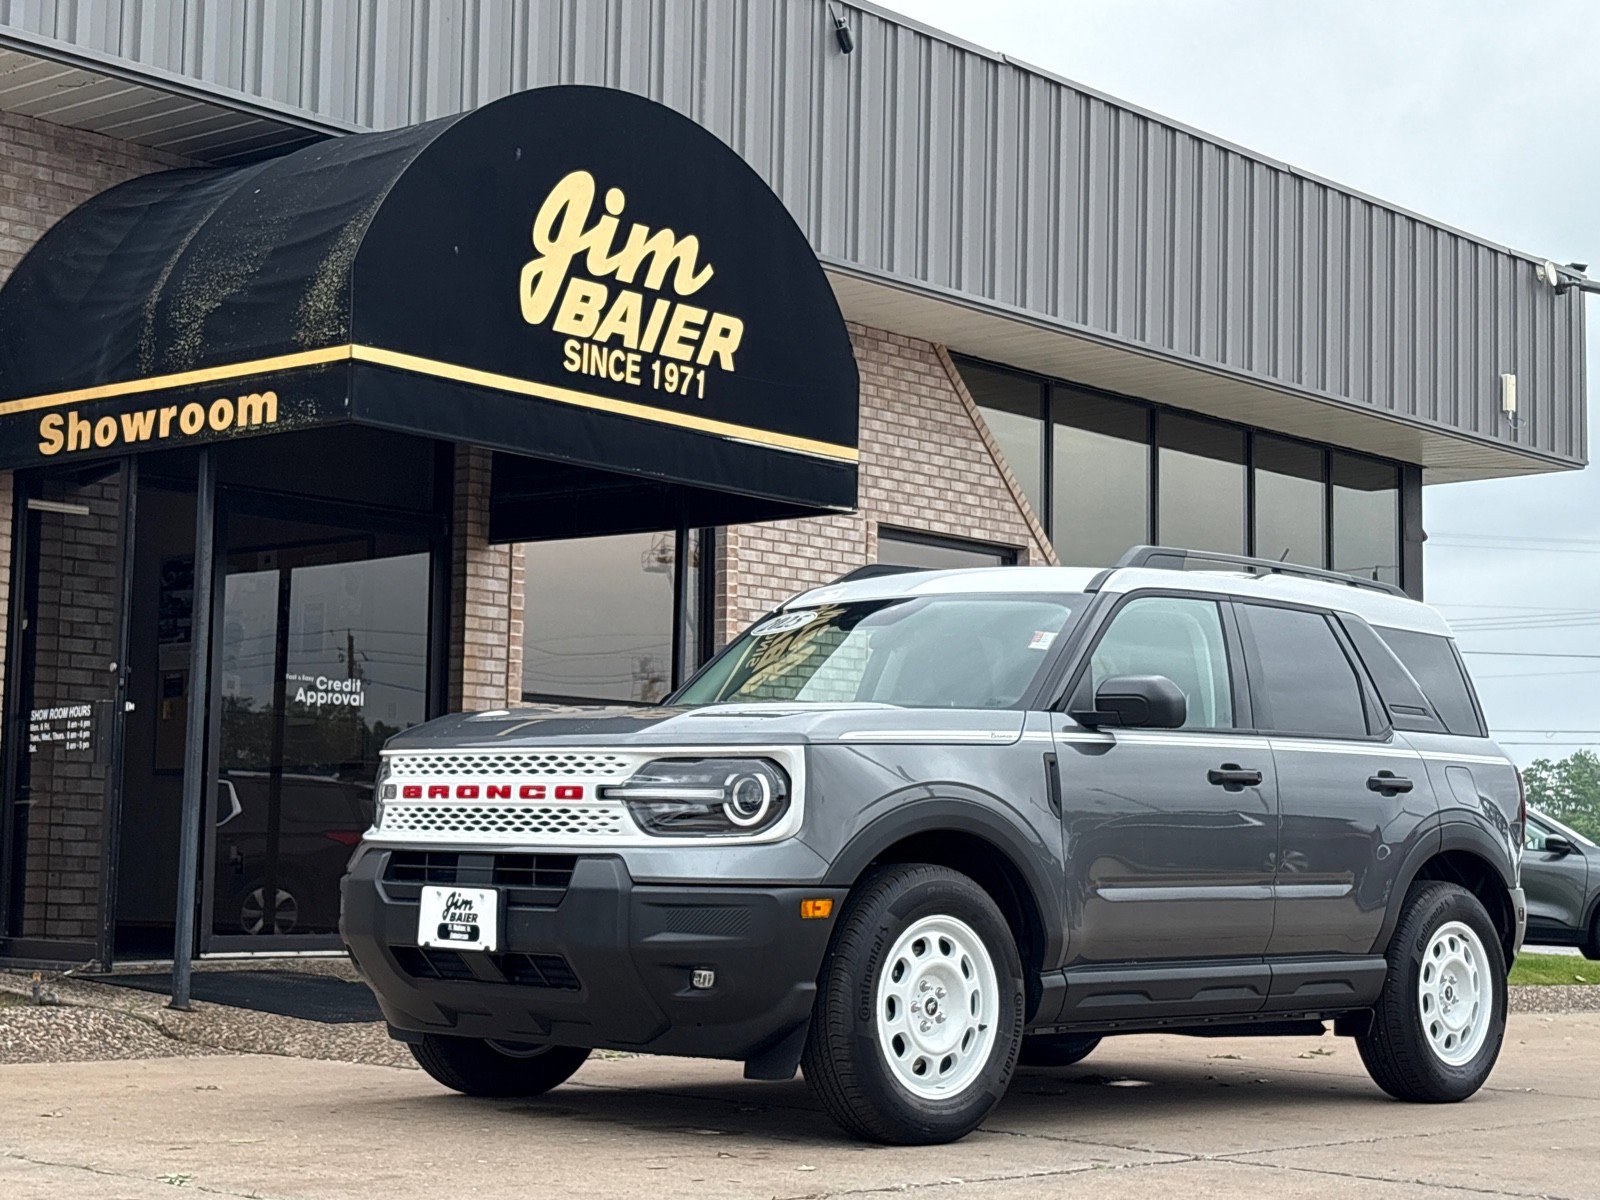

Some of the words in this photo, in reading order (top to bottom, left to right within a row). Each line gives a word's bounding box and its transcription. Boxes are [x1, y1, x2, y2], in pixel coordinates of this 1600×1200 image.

[520, 170, 714, 325] Jim
[552, 277, 744, 372] BAIER
[563, 339, 642, 386] SINCE
[652, 360, 706, 400] 1971
[38, 391, 279, 456] Showroom
[295, 687, 364, 707] Approval
[316, 676, 361, 693] Credit
[31, 709, 49, 721] SHOW
[50, 707, 69, 719] ROOM
[69, 705, 91, 717] HOURS
[402, 785, 584, 800] BRONCO
[442, 891, 473, 921] Jim
[449, 912, 479, 923] BAIER
[1416, 901, 1445, 952] Continental
[859, 934, 885, 1021] Continental
[1003, 992, 1023, 1076] Continental
